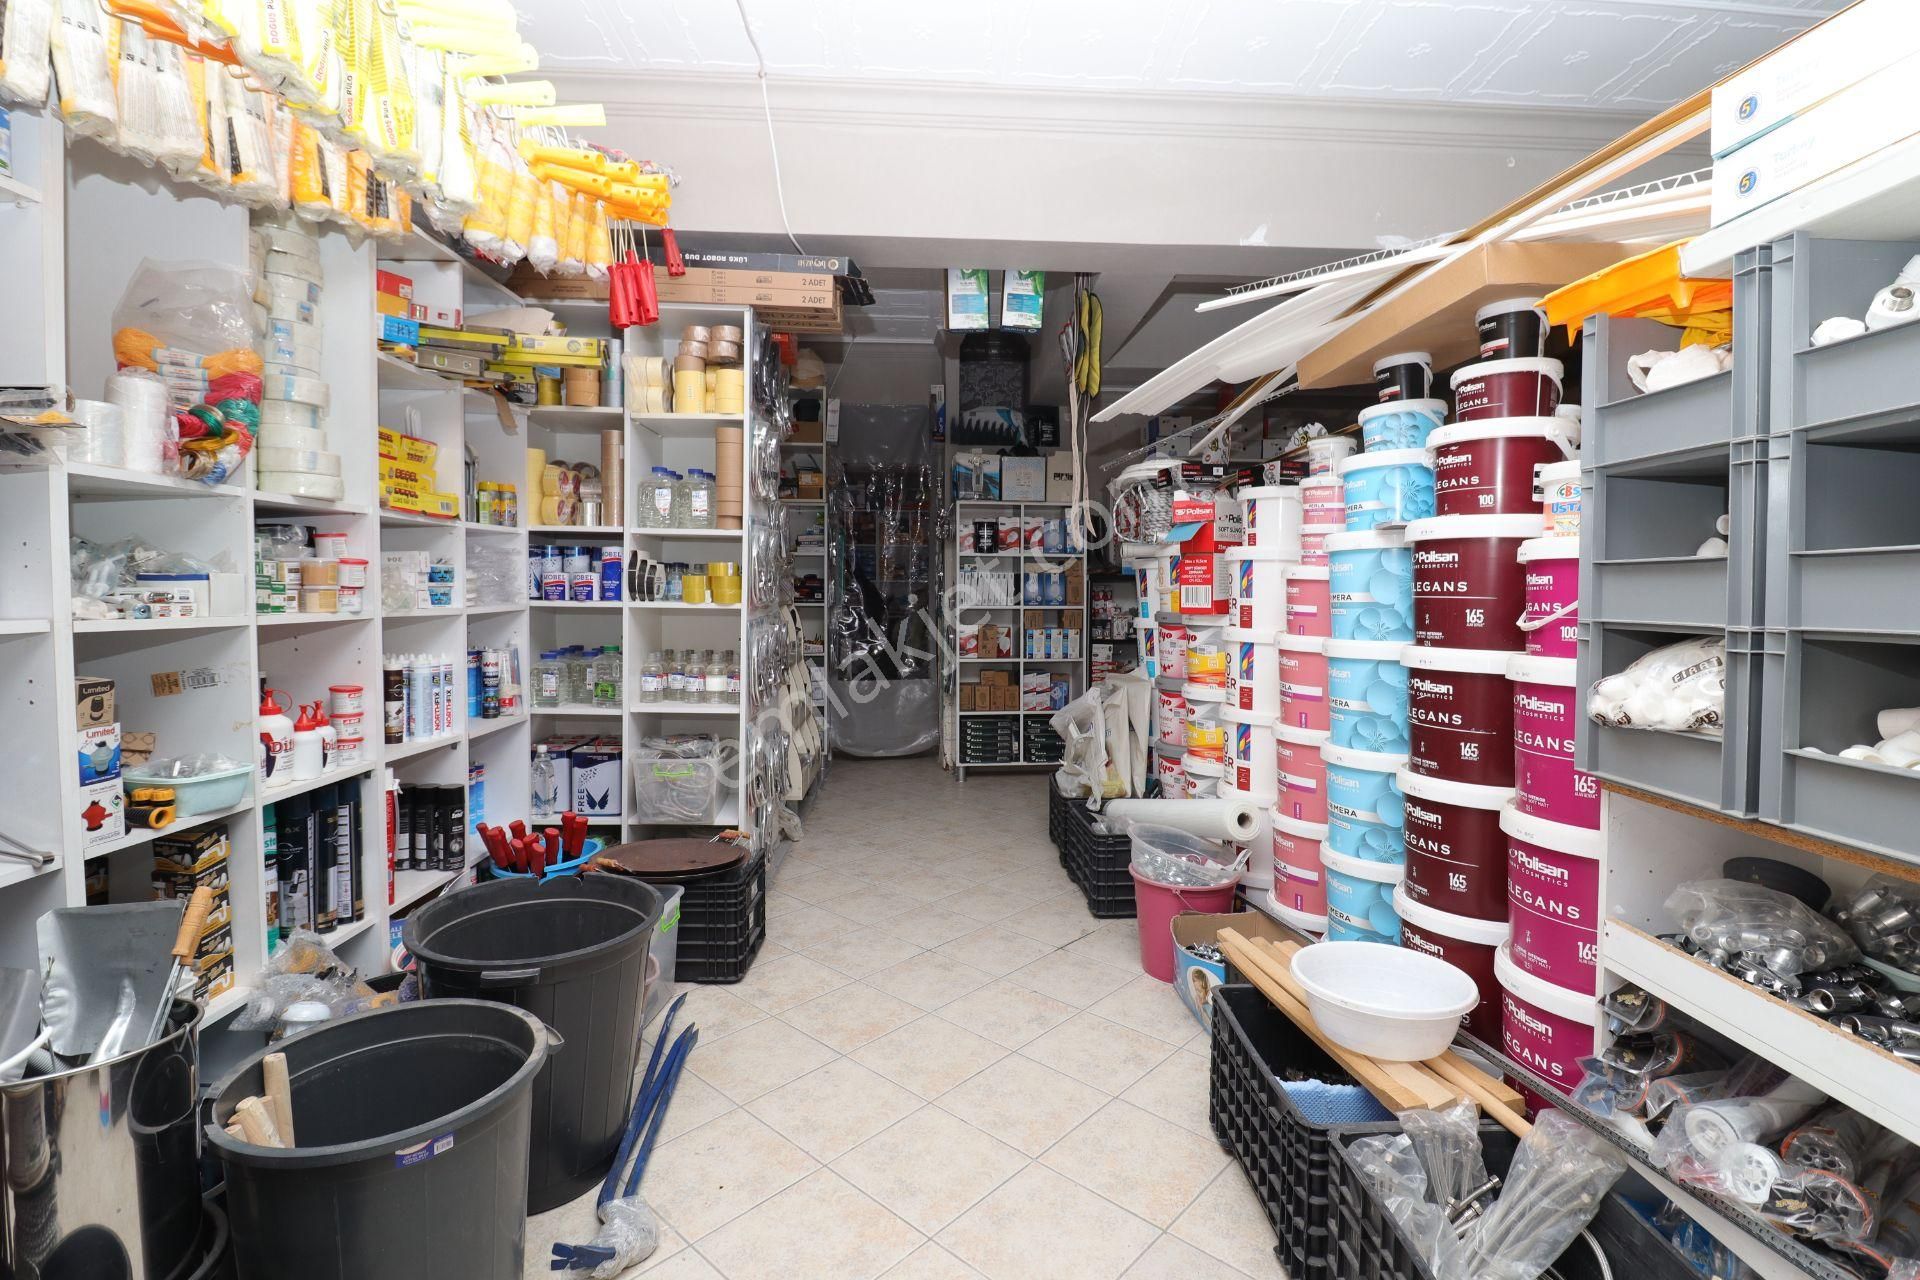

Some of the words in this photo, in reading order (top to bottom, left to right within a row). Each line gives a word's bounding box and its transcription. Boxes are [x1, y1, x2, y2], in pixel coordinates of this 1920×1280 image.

[801, 278, 807, 286] 2
[808, 279, 826, 287] ADET
[801, 296, 807, 304] 2
[808, 296, 826, 304] ADET
[1460, 382, 1485, 394] Polisan
[1456, 397, 1489, 411] LEGANS
[1439, 453, 1472, 466] Polisan
[1559, 485, 1582, 498] CBS
[1478, 494, 1494, 506] 100
[1229, 514, 1242, 524] Polis
[1418, 550, 1459, 562] Polisan
[1412, 581, 1468, 592] LEGANS
[1526, 574, 1553, 586] Polisan
[1465, 609, 1485, 624] 165
[1186, 633, 1198, 645] yo
[1560, 626, 1578, 639] 100
[1672, 656, 1723, 684] FIRAT
[82, 685, 111, 695] Limited
[1414, 678, 1453, 694] Polisan
[1416, 691, 1453, 701] COSMETICS
[1519, 694, 1565, 714] Polisan
[1407, 707, 1462, 725] LEGANS
[1522, 711, 1565, 722] COSMETICS
[86, 726, 116, 739] Limited
[1514, 730, 1576, 752] LEGANS
[1460, 742, 1479, 757] 165
[1573, 775, 1596, 794] 165
[577, 788, 585, 813] FREE
[1406, 802, 1442, 824] Polisan
[1518, 851, 1569, 881] Polisan
[1448, 872, 1466, 889] 165
[1521, 867, 1568, 888] COSMETICS
[1329, 906, 1352, 923] MERA
[1405, 928, 1444, 956] Polisan
[1577, 941, 1598, 961] 165
[1508, 1000, 1553, 1038] Polisan
[1502, 1025, 1564, 1077] LEGANS
